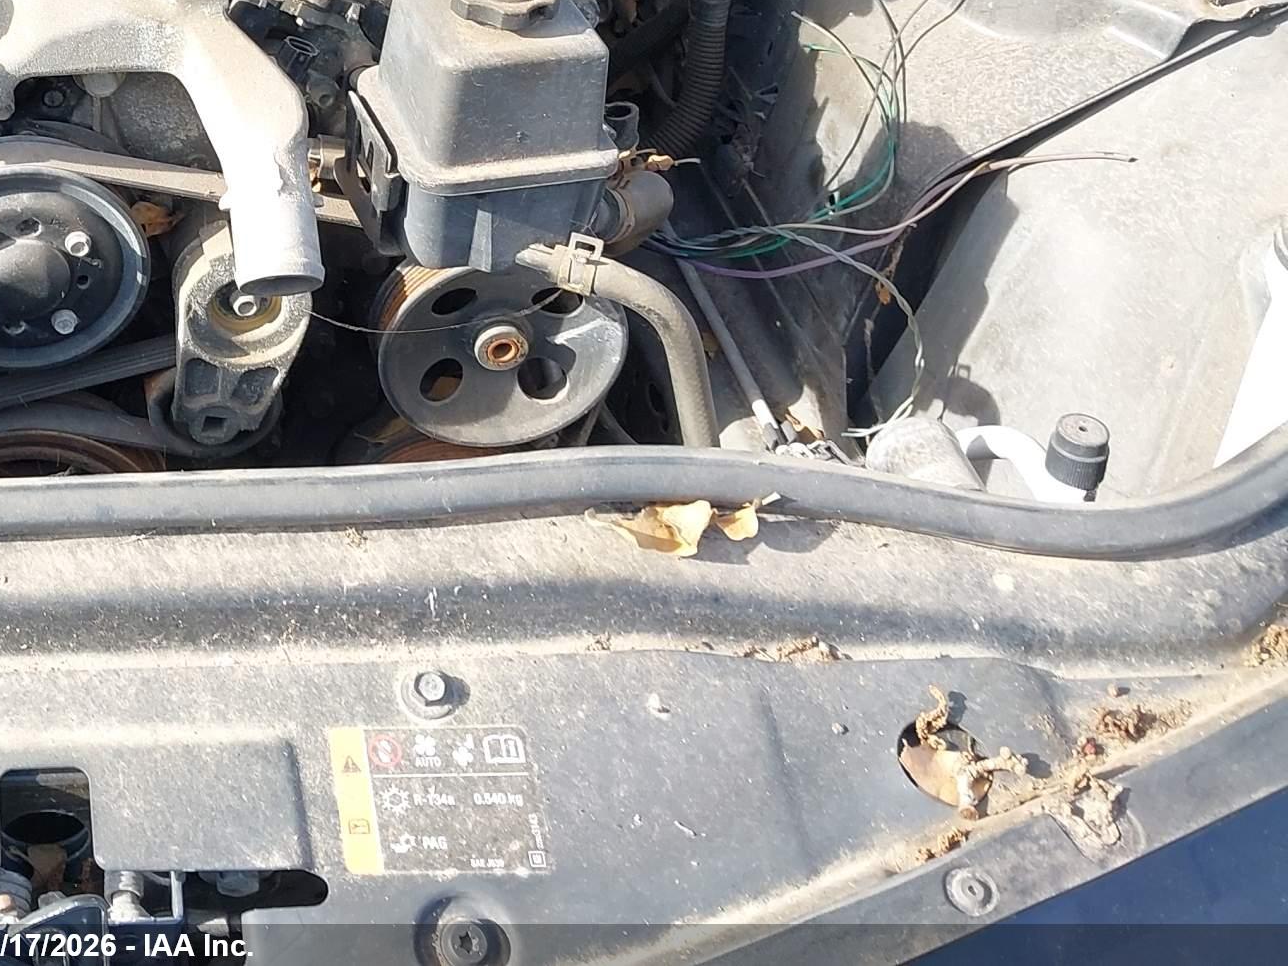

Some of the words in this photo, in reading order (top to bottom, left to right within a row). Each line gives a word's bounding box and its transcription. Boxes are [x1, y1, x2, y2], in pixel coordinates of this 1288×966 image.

[415, 756, 442, 768] AUTO
[412, 792, 456, 806] R-134a
[422, 835, 448, 850] PAG
